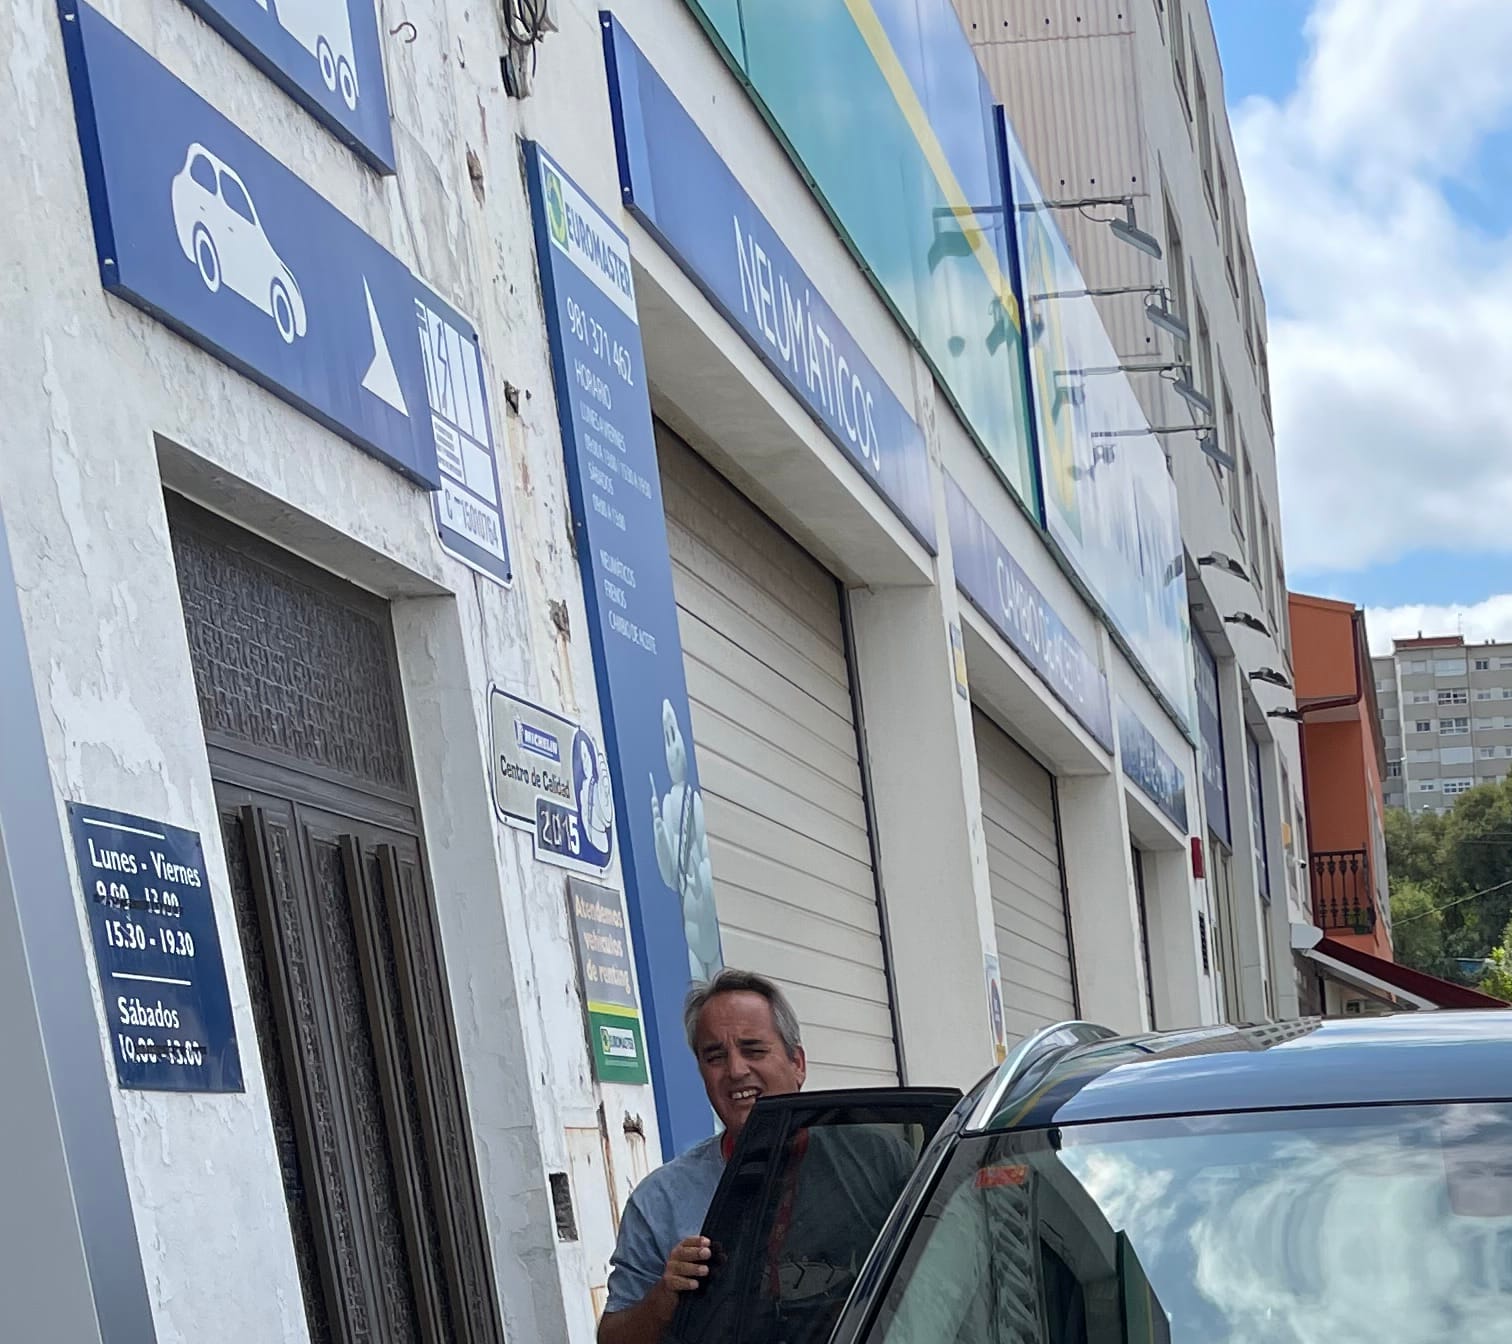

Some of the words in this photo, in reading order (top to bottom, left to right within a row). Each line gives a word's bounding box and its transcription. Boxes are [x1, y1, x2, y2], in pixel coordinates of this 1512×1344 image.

[565, 201, 633, 301] EUROMASTER
[567, 296, 589, 347] 981
[590, 317, 612, 367] 371
[613, 340, 634, 387] 462
[733, 215, 880, 472] NEUMÁTICOS
[574, 358, 611, 410] HORARIO
[500, 755, 529, 785] Centro
[531, 767, 541, 789] de
[542, 770, 571, 799] Calidad
[541, 810, 580, 856] 2015
[88, 838, 137, 875] Lunes
[150, 850, 201, 888] Viernes
[575, 895, 623, 929] Atendemos
[105, 919, 145, 950] 15.30
[159, 927, 195, 957] 19.30
[586, 959, 598, 982] de
[600, 965, 631, 995] renting
[118, 997, 179, 1029] Sábados
